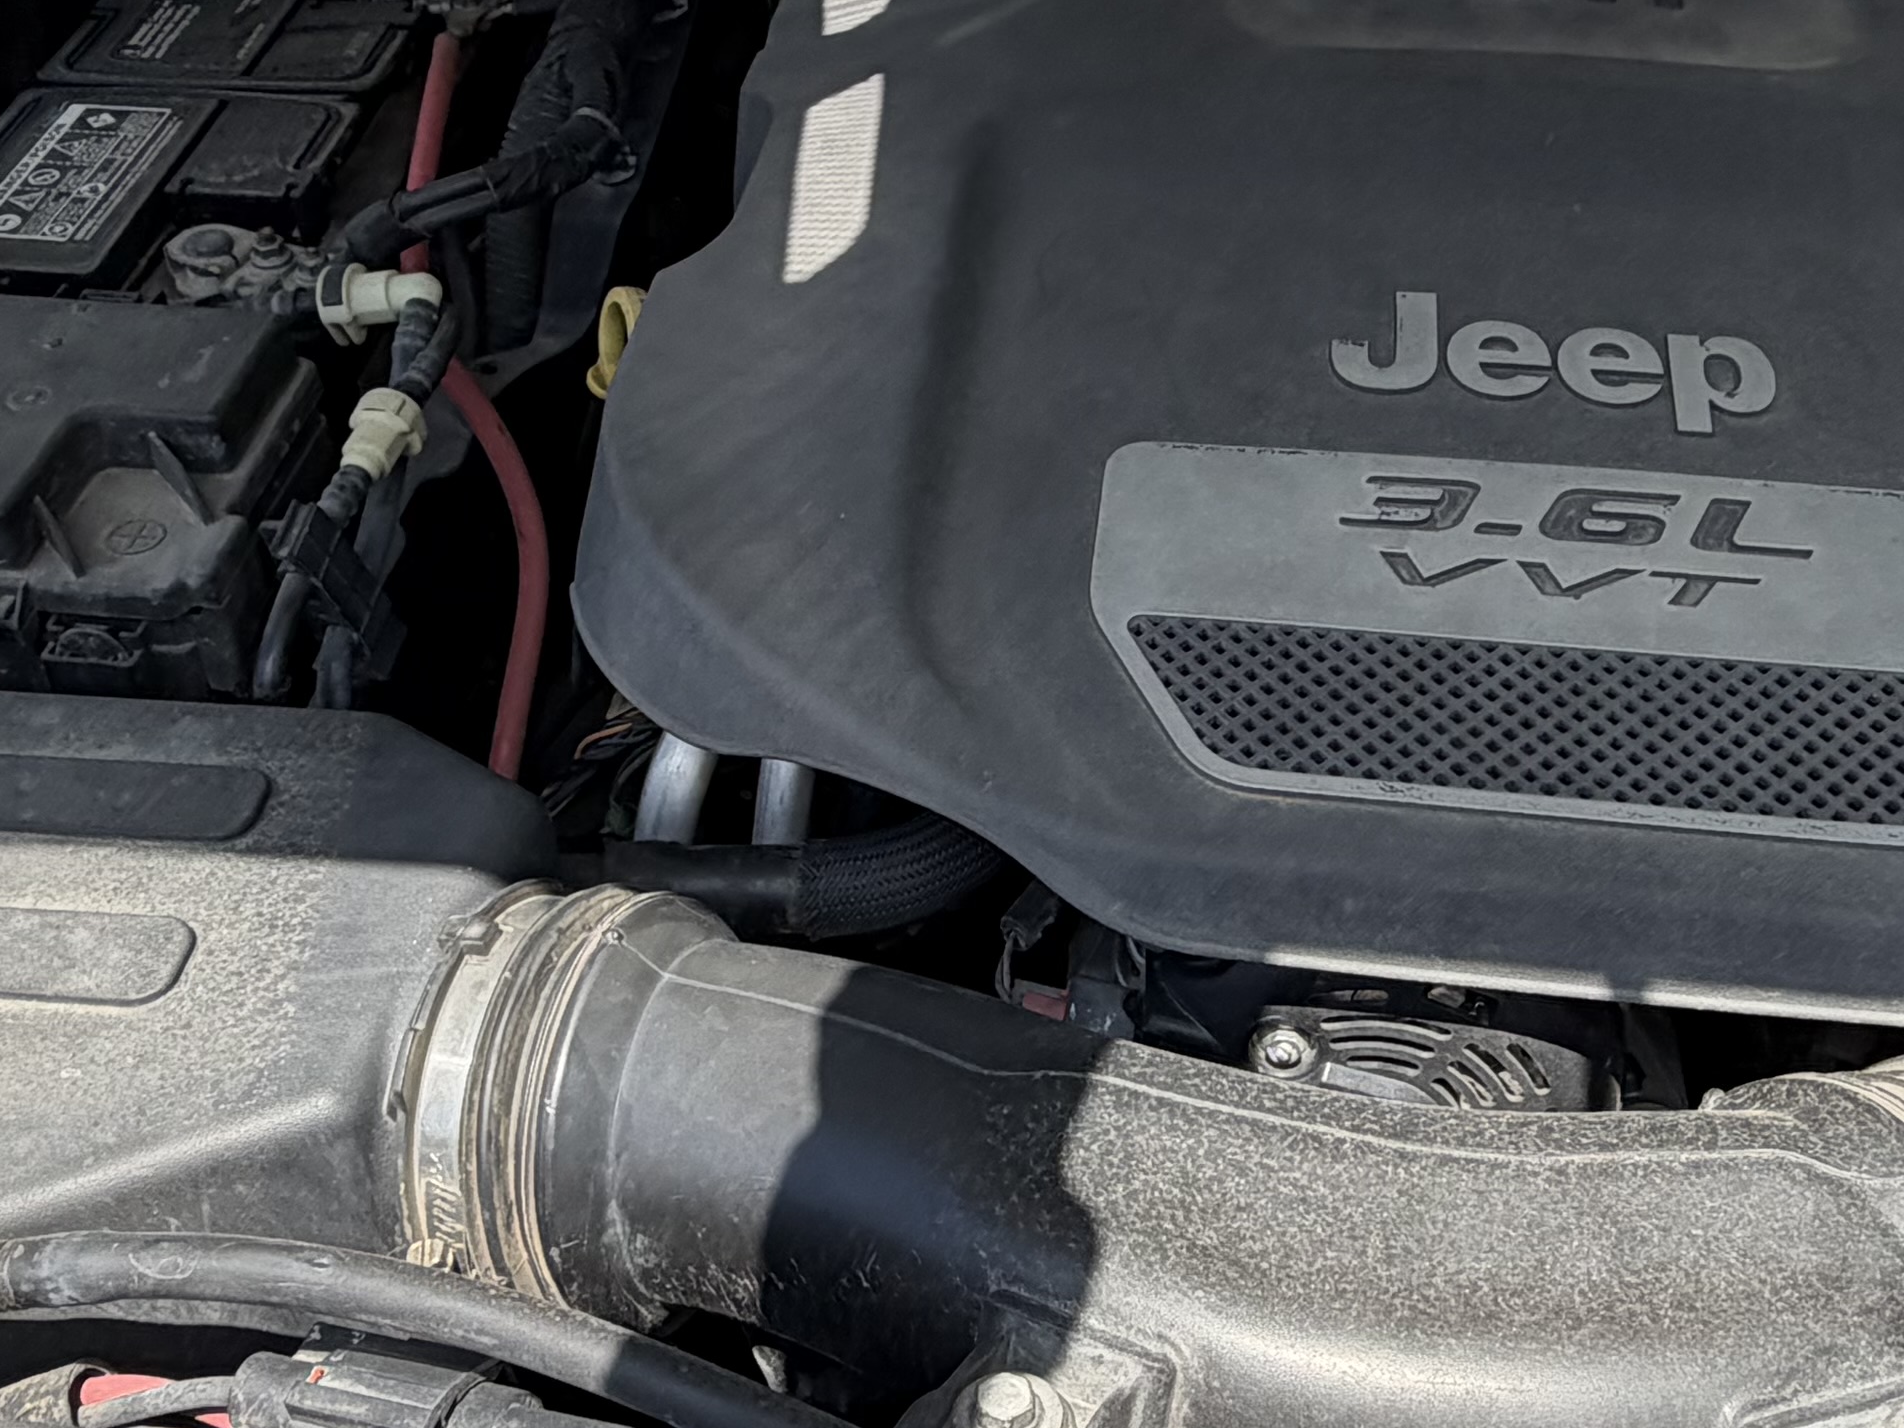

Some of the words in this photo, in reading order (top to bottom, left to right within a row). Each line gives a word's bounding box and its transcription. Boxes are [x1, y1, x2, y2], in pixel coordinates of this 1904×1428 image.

[1329, 290, 1777, 436] Jeep
[1339, 474, 1813, 560] 3.6L
[1380, 549, 1760, 607] VVT
